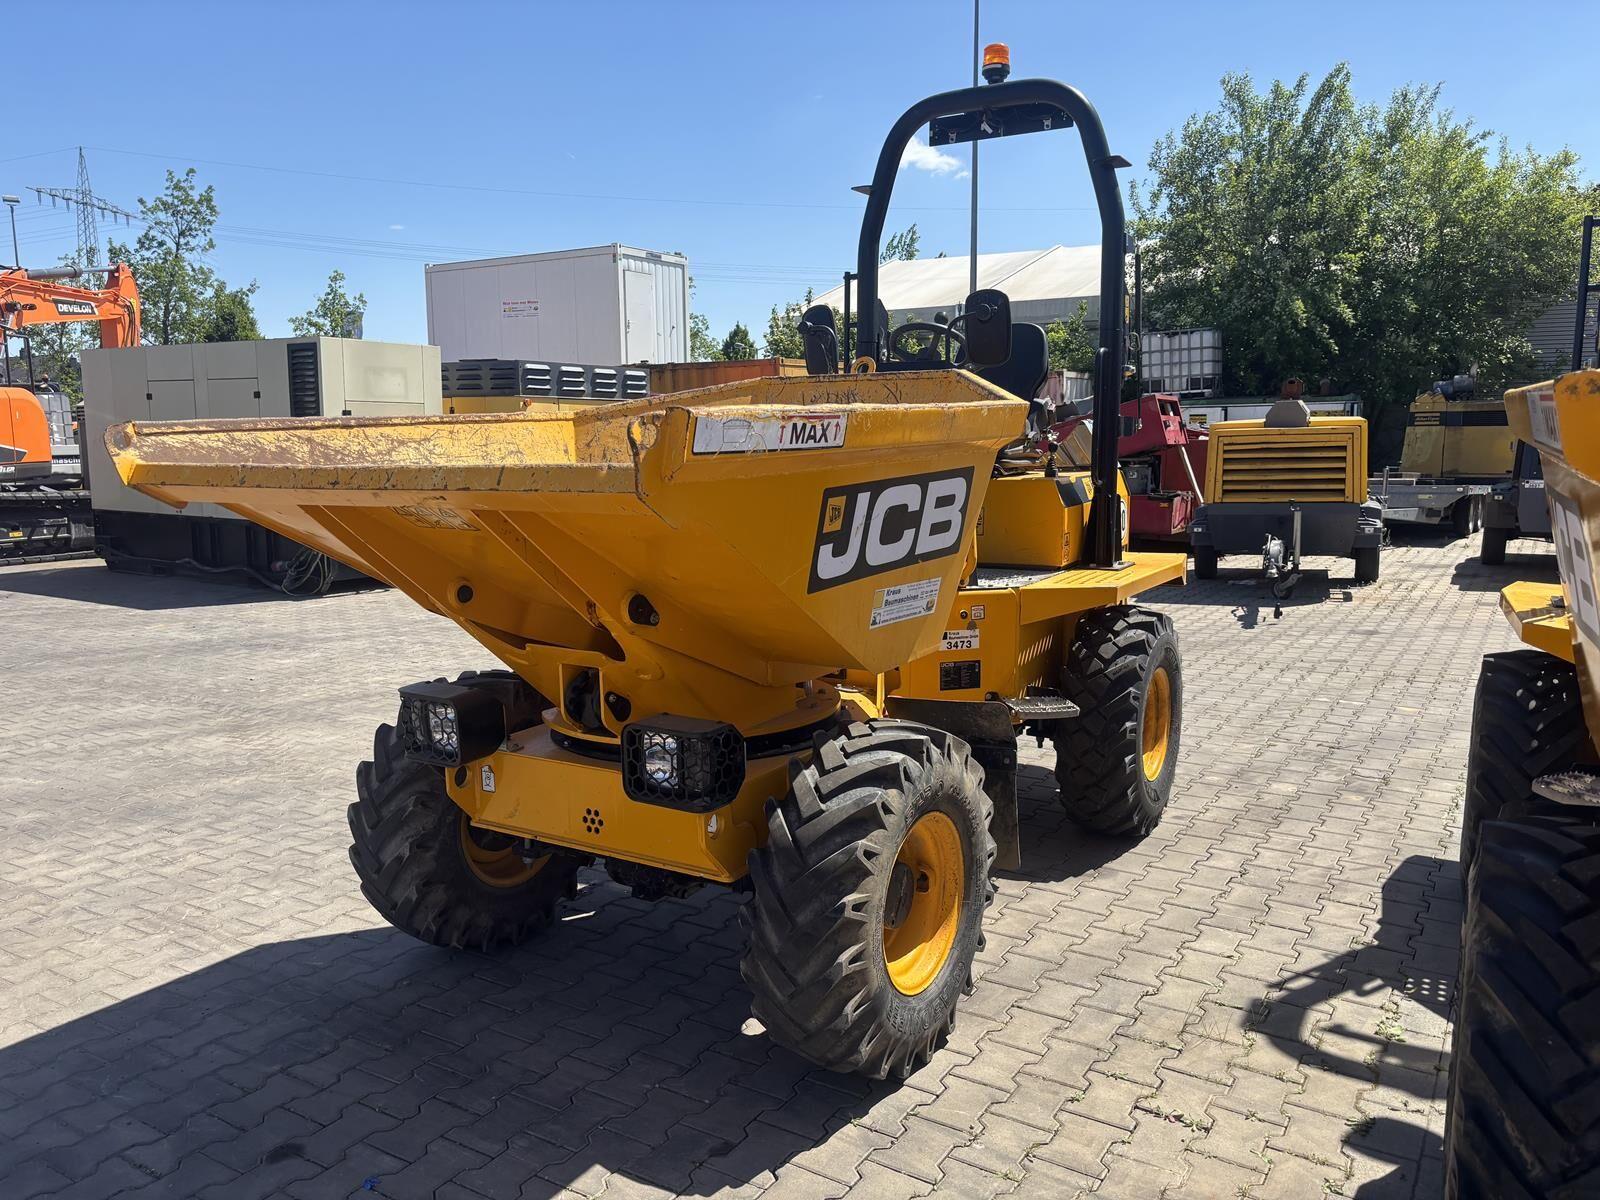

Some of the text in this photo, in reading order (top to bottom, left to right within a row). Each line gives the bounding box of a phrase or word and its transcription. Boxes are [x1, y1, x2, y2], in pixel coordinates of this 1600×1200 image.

[58, 303, 92, 314] DEVELON
[789, 421, 831, 445] MAX
[817, 477, 967, 580] JCB
[886, 588, 902, 597] Kraus
[884, 594, 919, 607] Baumaschinen
[946, 639, 972, 650] 3473
